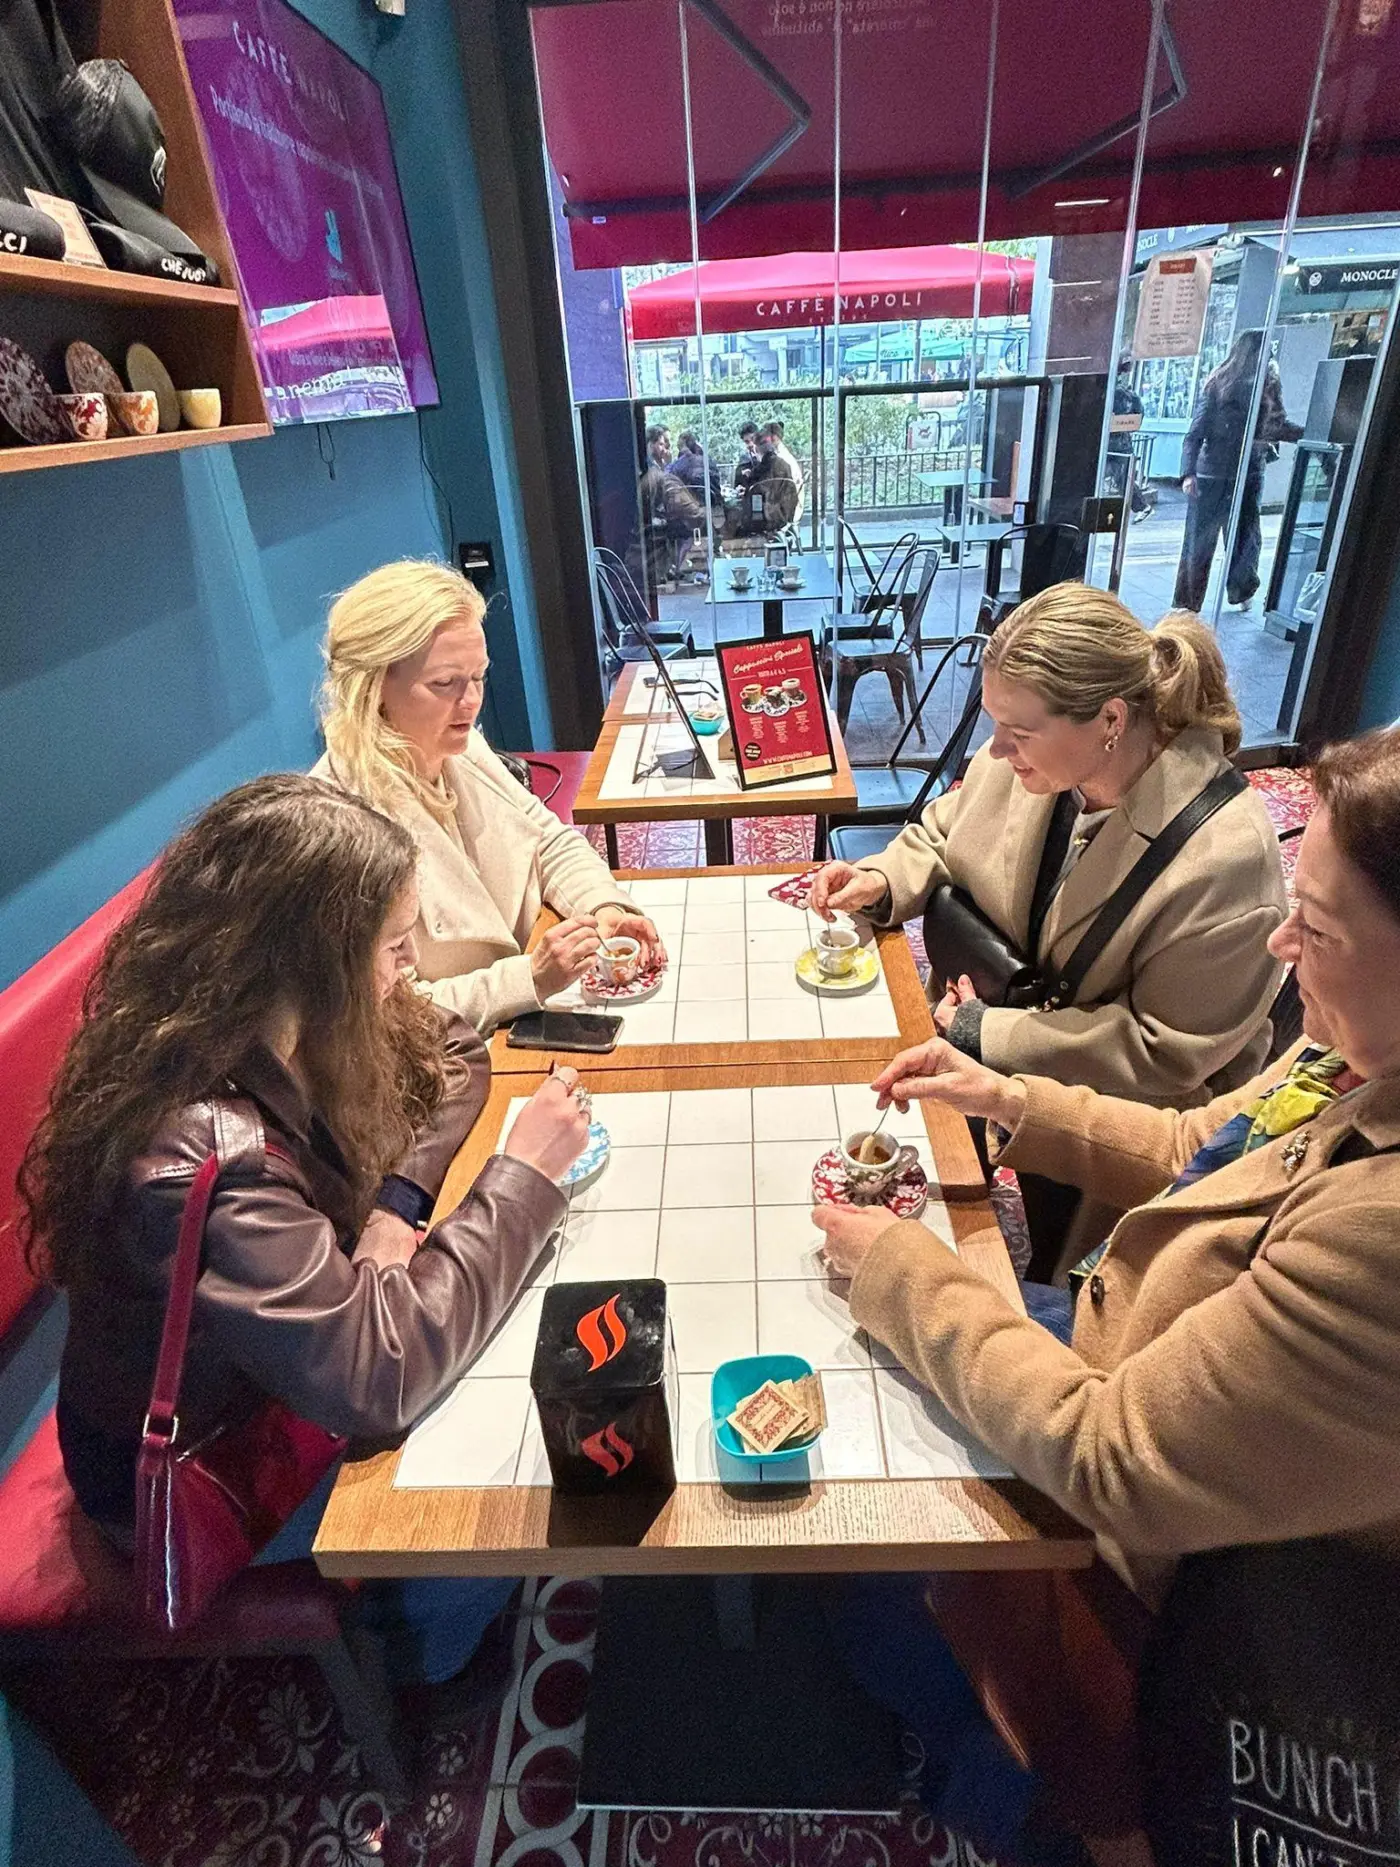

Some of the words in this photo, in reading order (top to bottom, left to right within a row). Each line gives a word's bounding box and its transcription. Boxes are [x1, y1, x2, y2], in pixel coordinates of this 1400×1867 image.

[161, 257, 182, 275] CHE
[756, 293, 825, 316] CAFFÈ
[838, 291, 921, 310] NAPOLI
[1230, 1719, 1380, 1833] BUNCH
